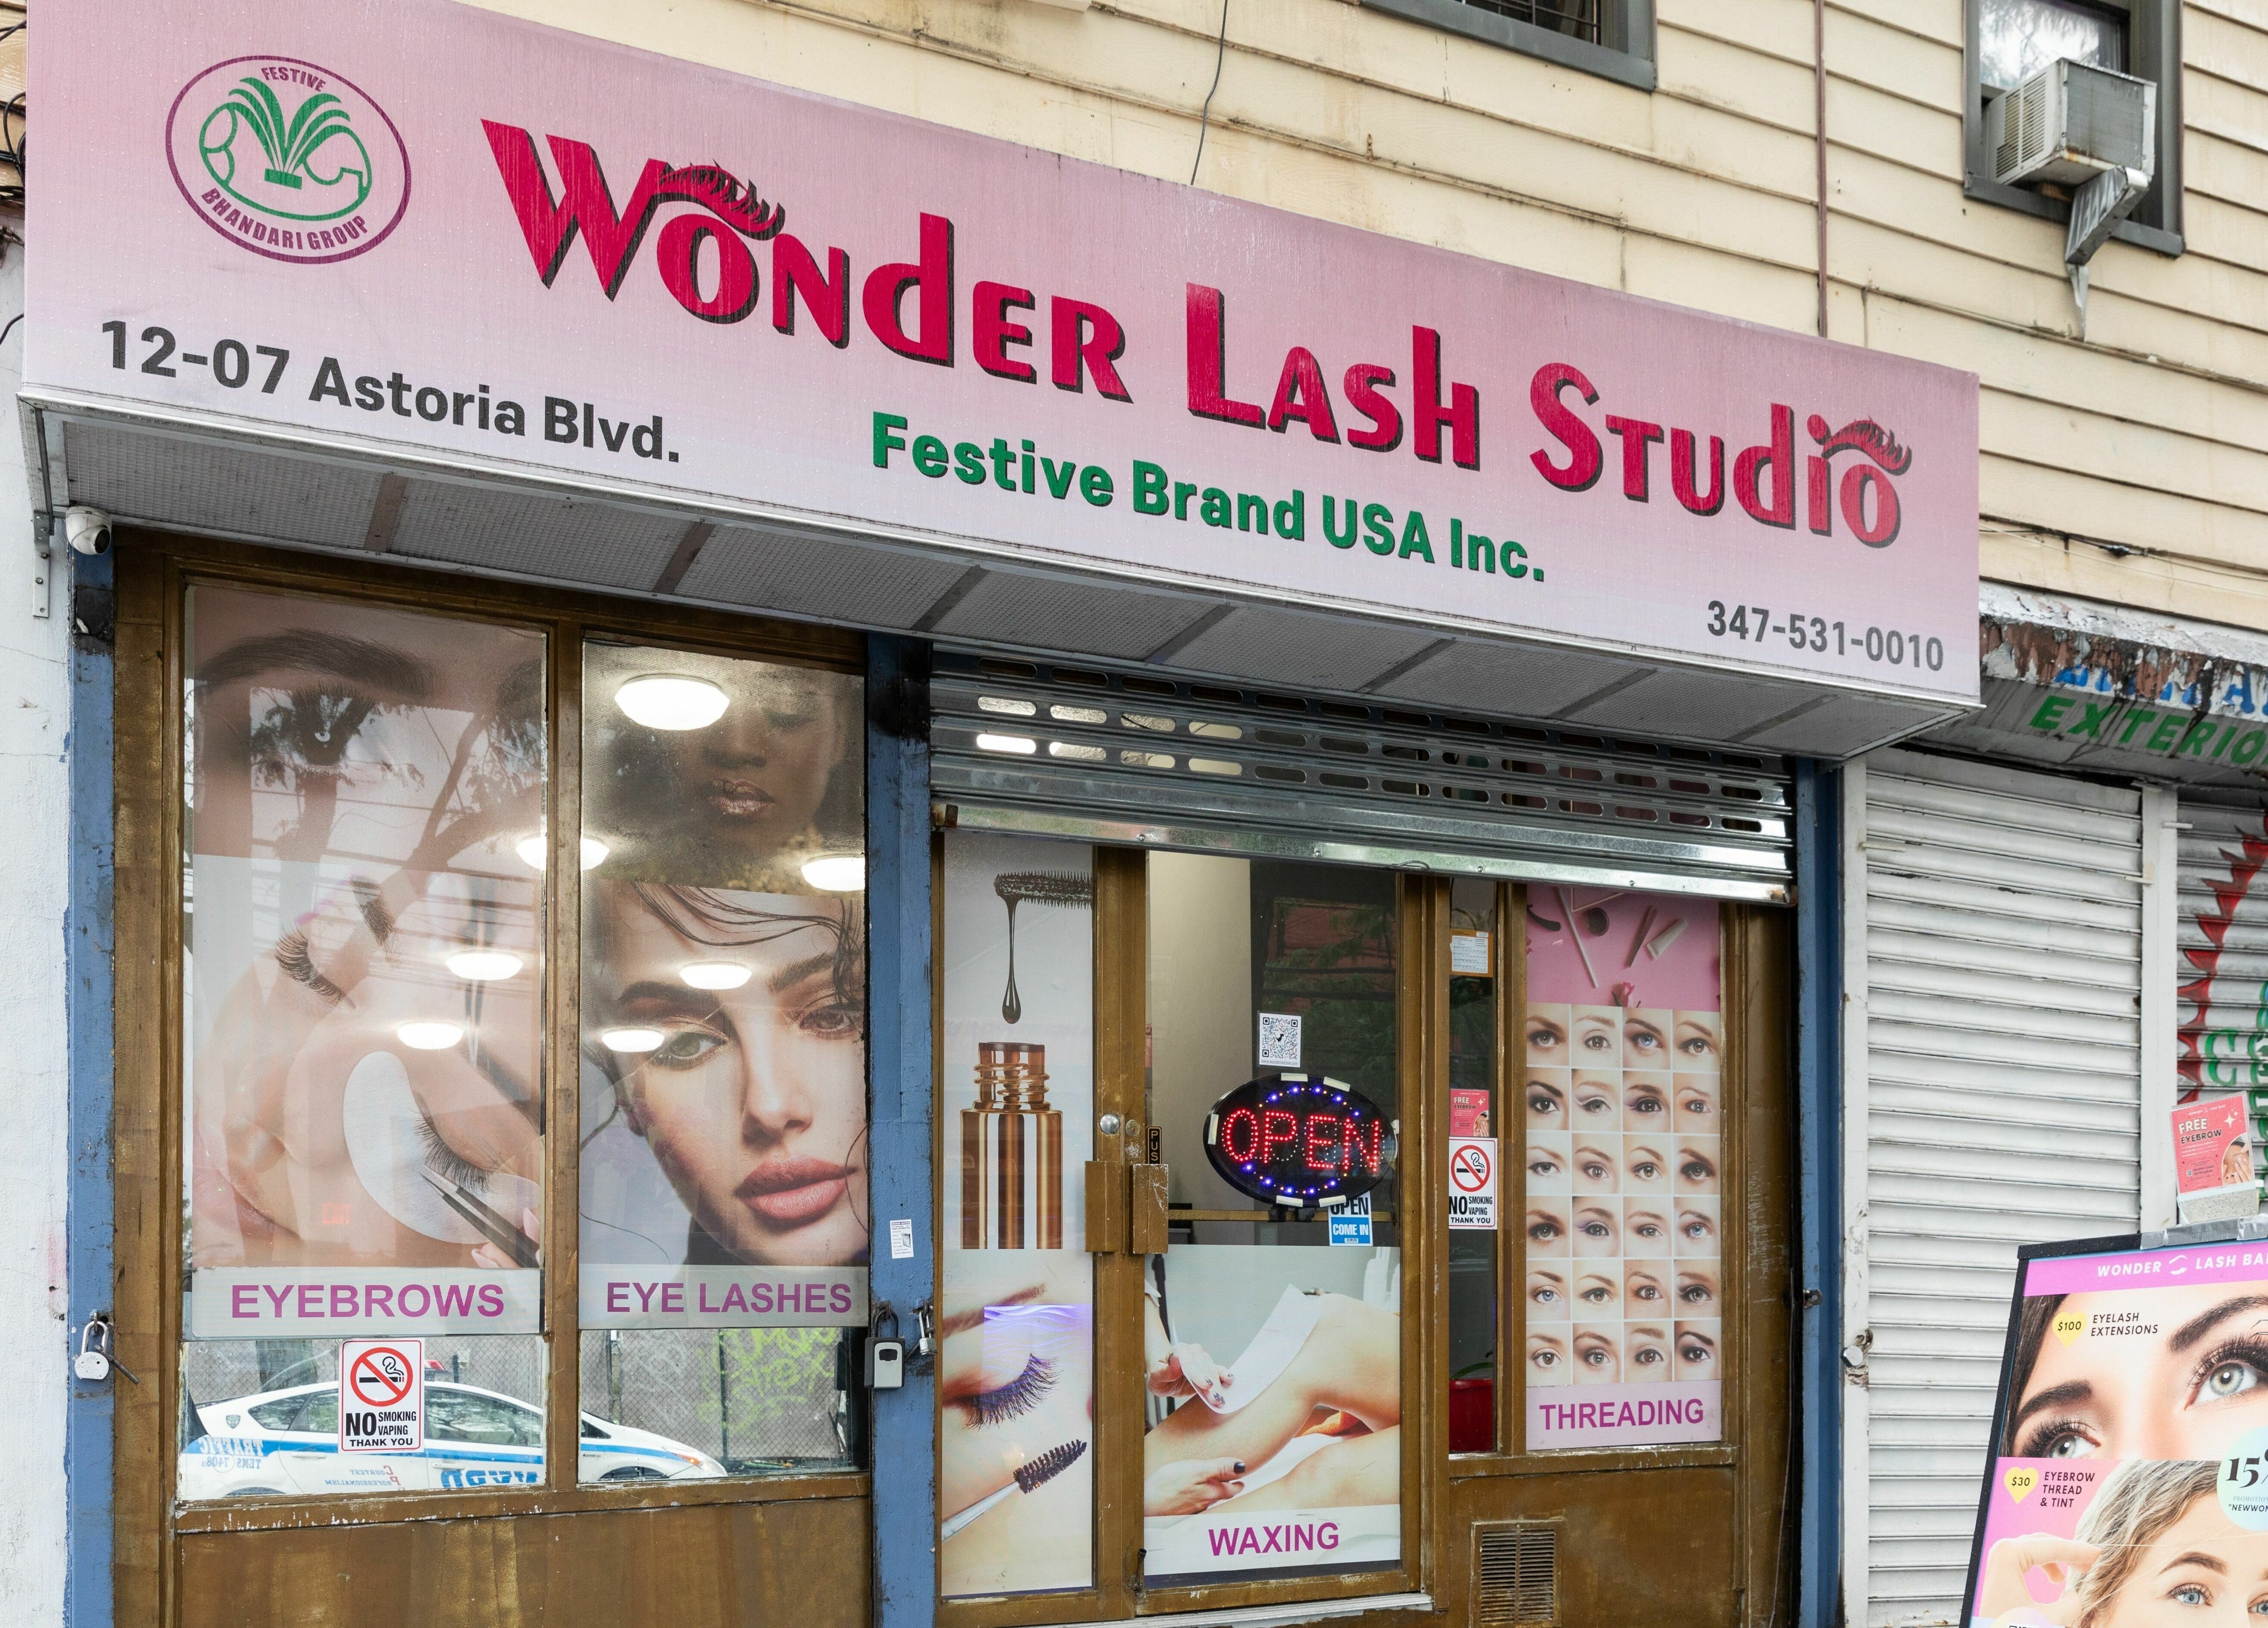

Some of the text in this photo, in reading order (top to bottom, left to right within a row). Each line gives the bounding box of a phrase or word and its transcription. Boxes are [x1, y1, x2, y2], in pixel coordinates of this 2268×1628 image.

[261, 66, 327, 92] FESTIVE
[201, 188, 369, 250] BHANDARI GROUP
[102, 320, 679, 463] 12-07 Astoria Blvd.
[873, 411, 1544, 582] Festive Brand USA Inc.
[1707, 600, 1944, 672] 347-531-0010
[2029, 695, 2268, 765] EXTERIO
[2178, 1118, 2208, 1135] FREE
[1224, 1108, 1380, 1173] OPEN
[2181, 1129, 2222, 1144] EYEBROW
[1330, 1197, 1369, 1215] OPEN
[1449, 1196, 1493, 1215] NO SMOKING
[1468, 1207, 1488, 1215] VAPING
[1332, 1223, 1369, 1236] COME IN
[2097, 1252, 2268, 1277] WONDER LASH BA
[232, 1284, 505, 1318] EYEBROWS
[607, 1282, 852, 1314] EYE LASHES
[2058, 1321, 2082, 1332] $100
[2093, 1312, 2140, 1324] EYELASH
[2090, 1324, 2159, 1337] EXTENSIONS
[1539, 1398, 1704, 1430] THREADING
[346, 1411, 417, 1437] NO SMOKING
[378, 1425, 408, 1436] VAPING
[349, 1438, 413, 1447] THANK YOU
[2044, 1471, 2096, 1482] EYEBROW
[2225, 1448, 2268, 1489] 15
[2011, 1477, 2031, 1487] $30
[2042, 1484, 2083, 1495] THREAD
[2040, 1497, 2074, 1508] & TINT
[1208, 1522, 1340, 1557] WAXING
